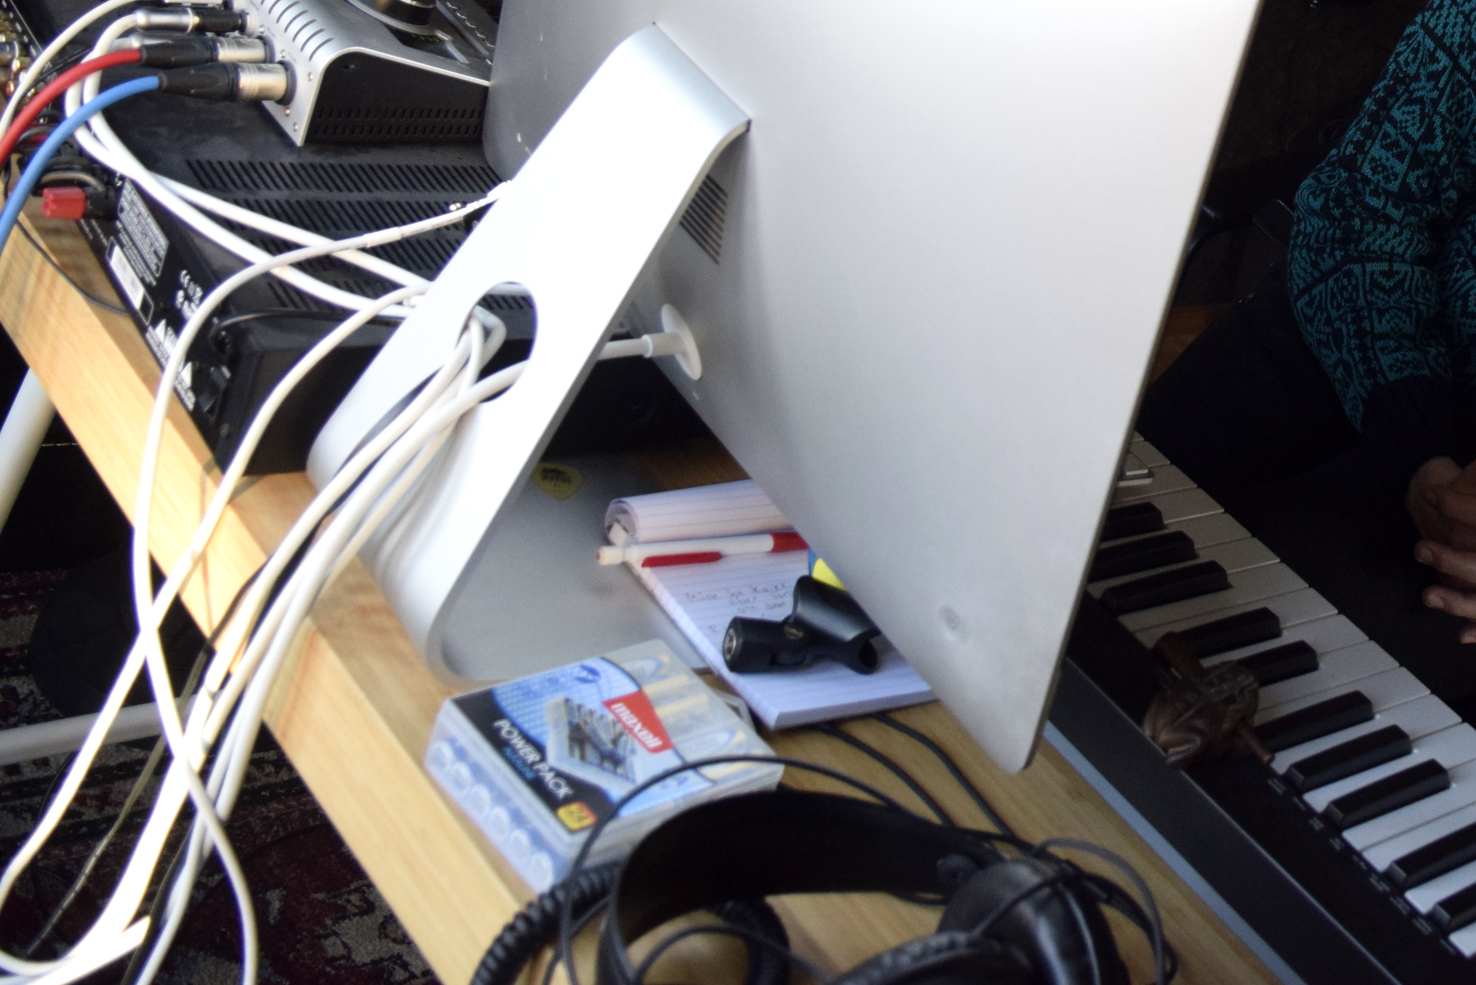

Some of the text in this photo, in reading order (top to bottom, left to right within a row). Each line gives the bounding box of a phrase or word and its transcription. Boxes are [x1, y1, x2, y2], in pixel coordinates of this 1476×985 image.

[611, 702, 664, 749] maxell
[493, 719, 574, 800] POWER PACK
